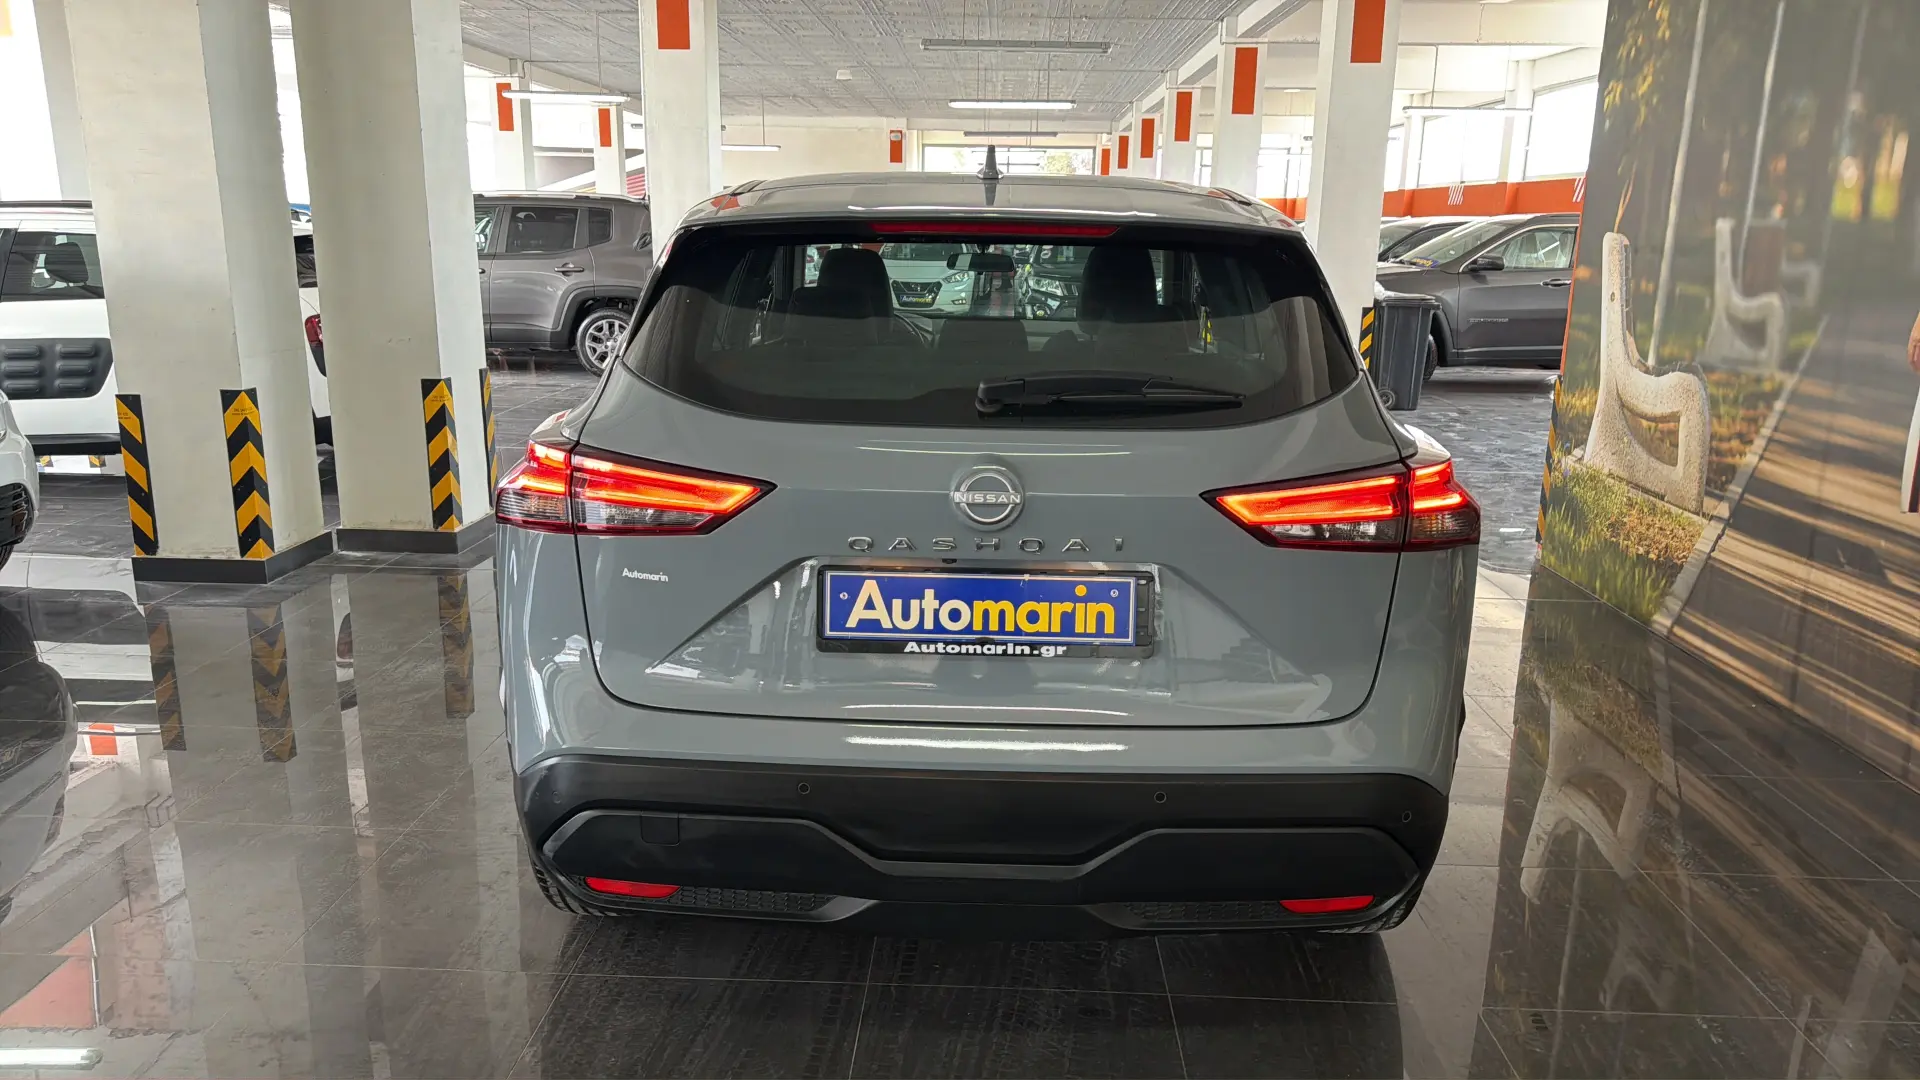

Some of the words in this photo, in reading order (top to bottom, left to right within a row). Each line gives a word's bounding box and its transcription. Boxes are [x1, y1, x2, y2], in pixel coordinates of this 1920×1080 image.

[956, 492, 1021, 504] NISSAN
[848, 536, 1124, 554] QASHQAI
[621, 567, 669, 582] Automarin
[845, 579, 1115, 634] Automarin
[903, 641, 1067, 657] Automarin.gr
